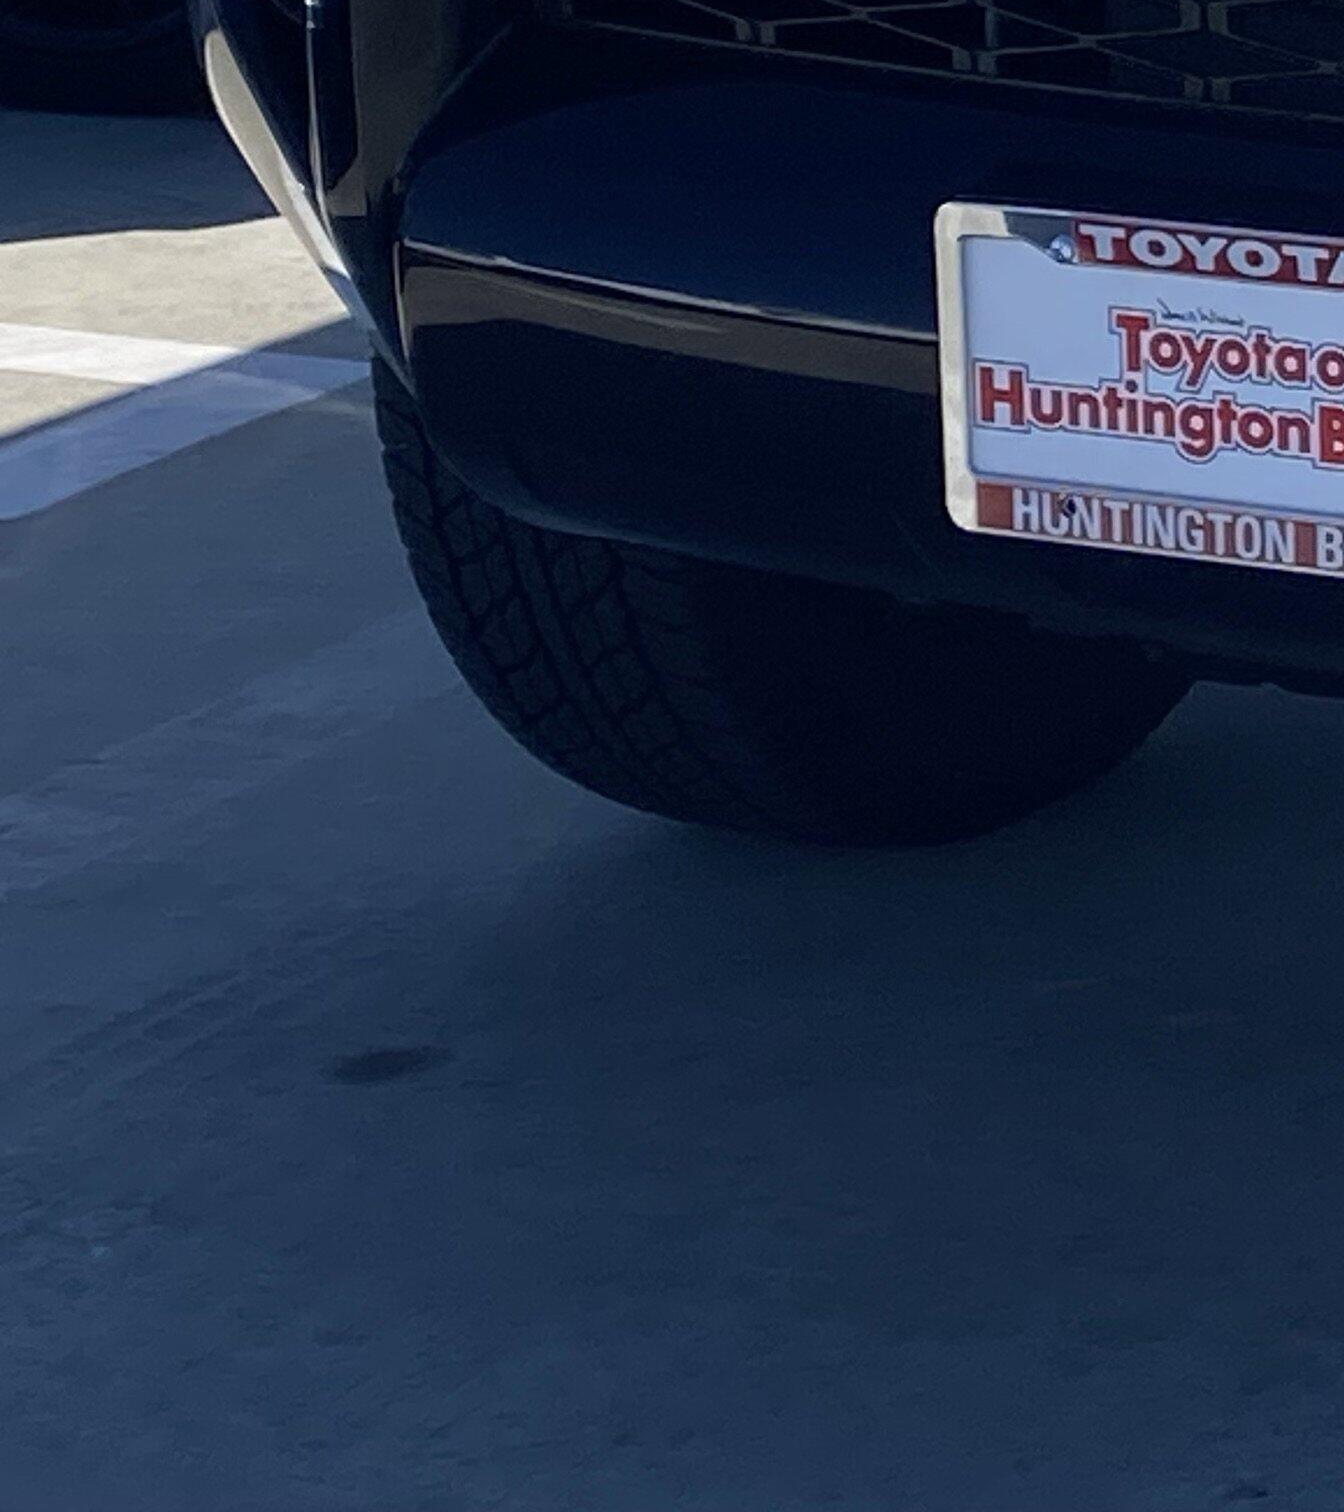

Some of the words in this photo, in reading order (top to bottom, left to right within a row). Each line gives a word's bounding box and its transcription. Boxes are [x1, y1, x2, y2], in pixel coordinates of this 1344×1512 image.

[1114, 312, 1311, 387] Toyota
[977, 365, 1311, 458] Huntington
[1012, 487, 1297, 565] HUNTINGTON
